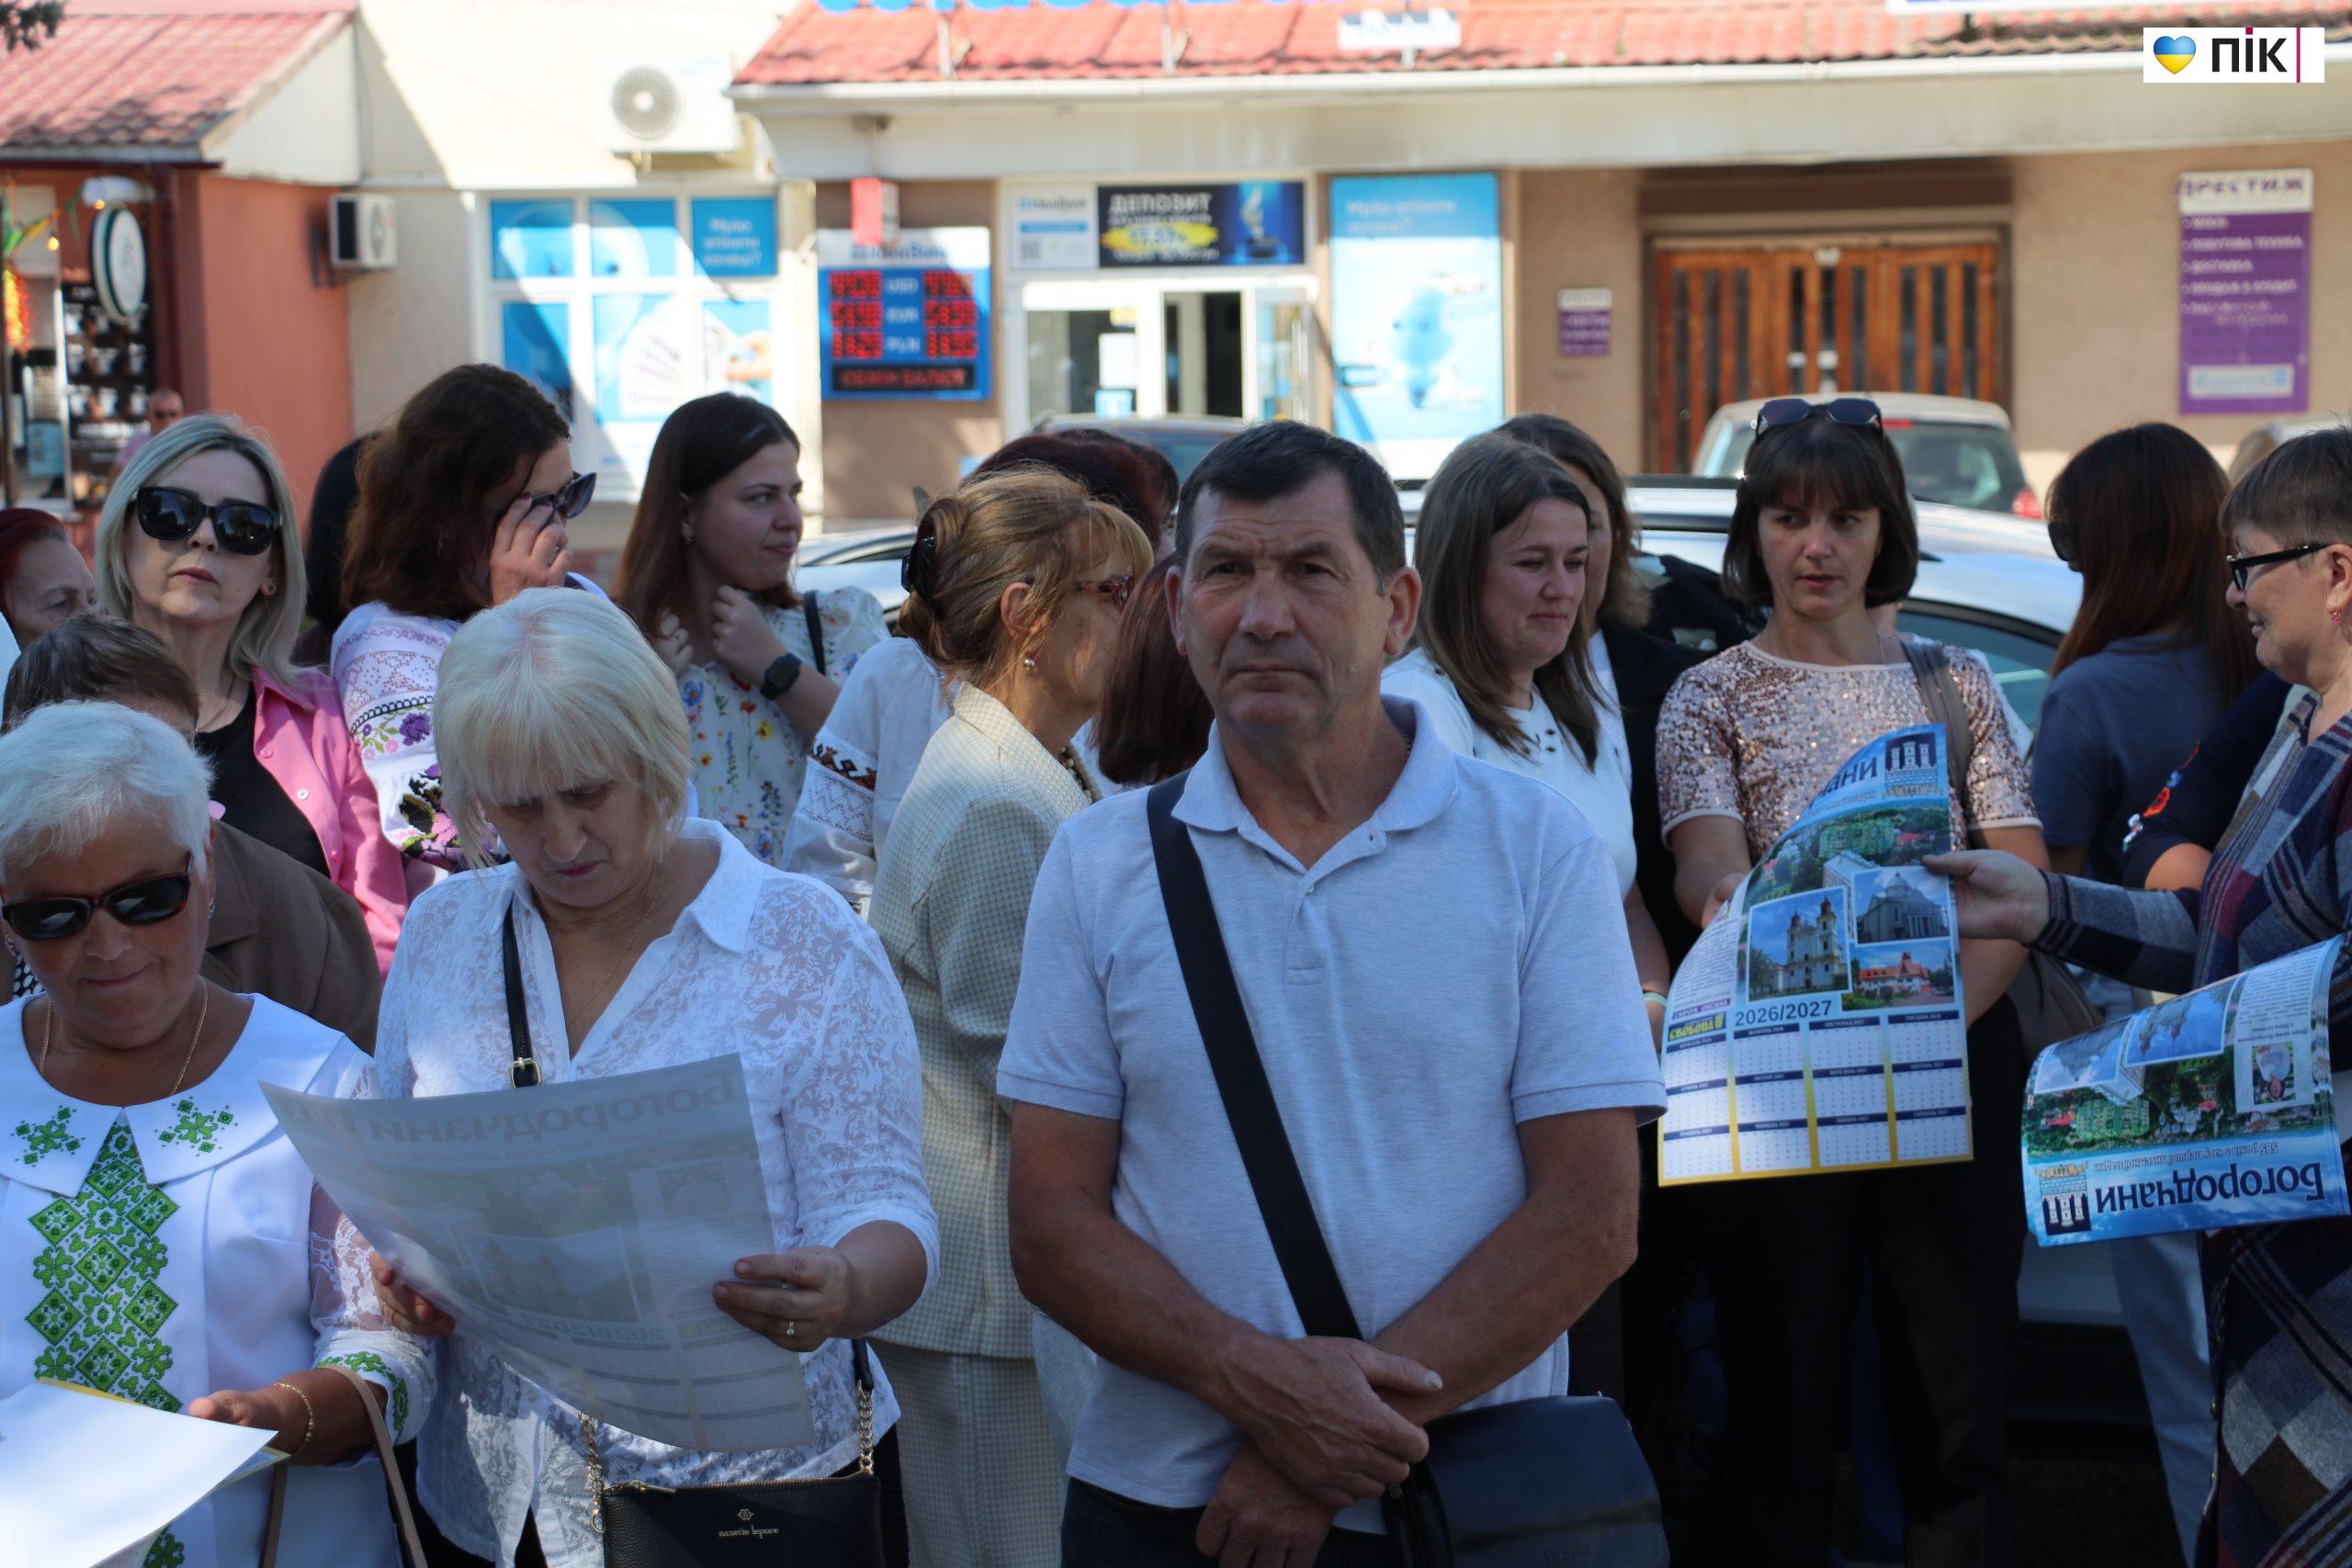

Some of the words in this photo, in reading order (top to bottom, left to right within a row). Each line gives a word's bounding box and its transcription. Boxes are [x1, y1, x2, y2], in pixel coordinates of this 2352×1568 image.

[1109, 193, 1212, 216] ДЕПОЗИТ
[1735, 999, 1832, 1026] 2026/2027
[1668, 1021, 1713, 1040] СВОБОДА
[2260, 1141, 2278, 1154] 585
[2096, 1162, 2325, 1213] Богородчани
[752, 1524, 779, 1539] lepore
